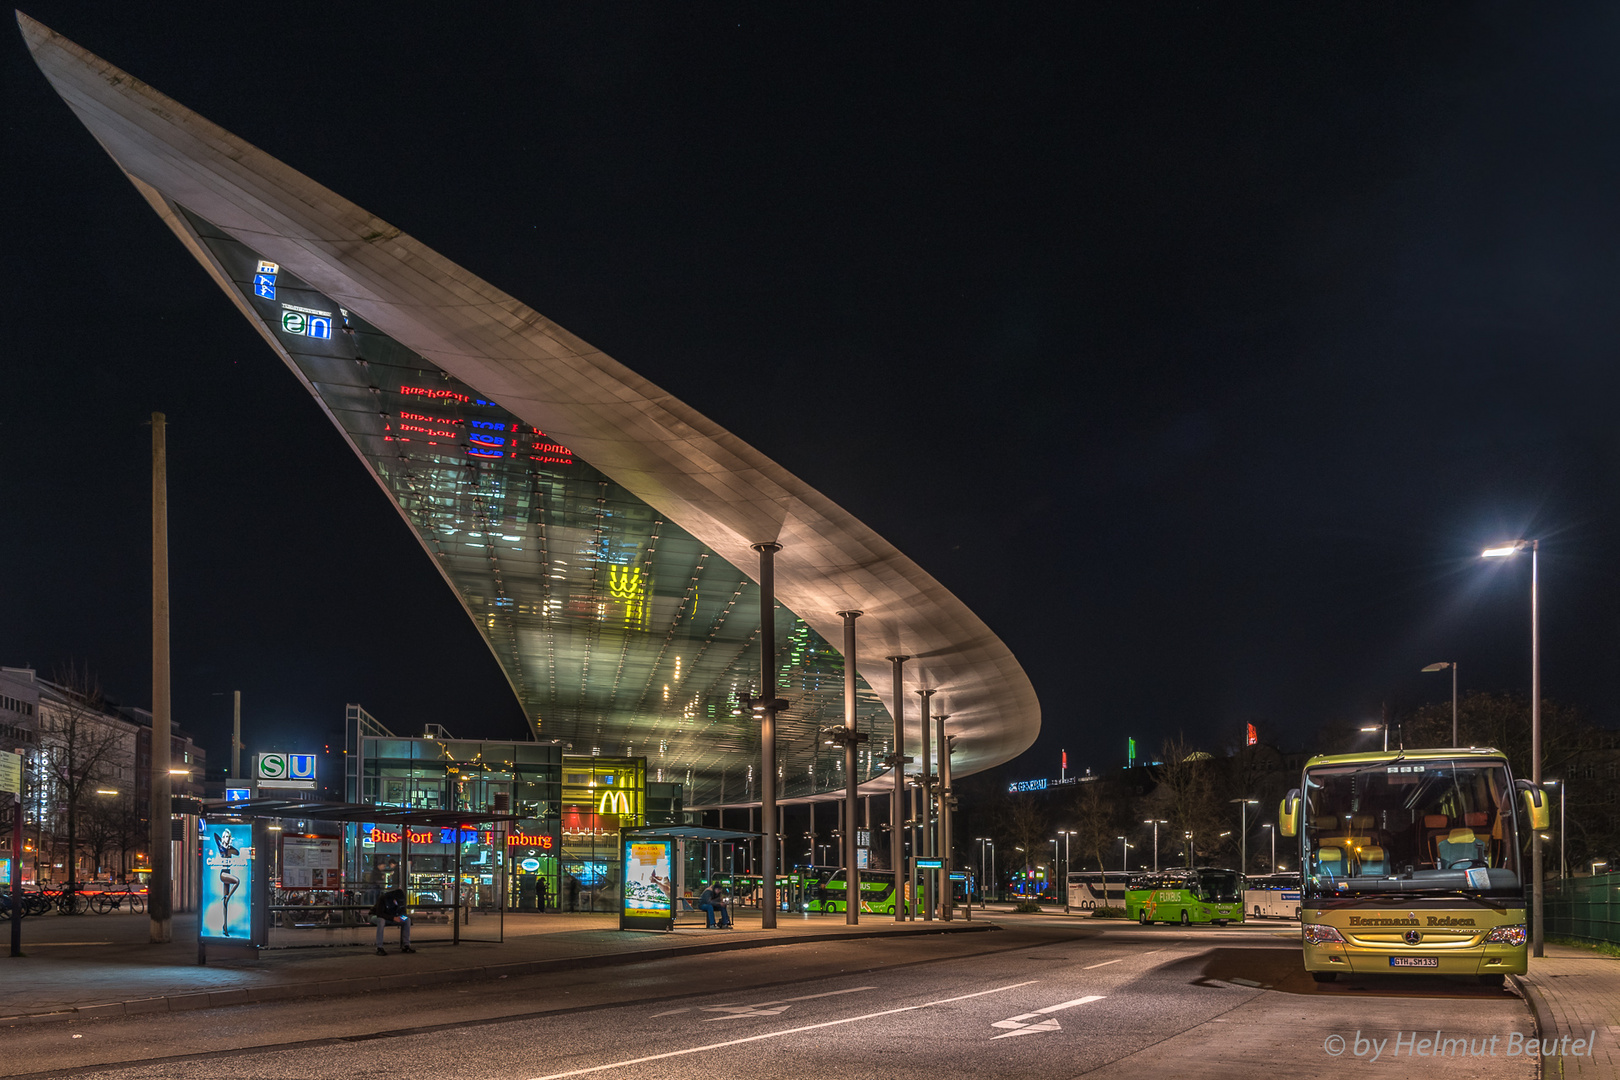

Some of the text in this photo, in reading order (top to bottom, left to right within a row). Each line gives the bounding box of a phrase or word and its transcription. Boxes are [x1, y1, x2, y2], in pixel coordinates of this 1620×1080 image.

[262, 755, 312, 777] S U
[485, 831, 552, 849] Hmburg
[1349, 916, 1476, 926] Herrmann Reisen
[1395, 958, 1409, 966] GTH
